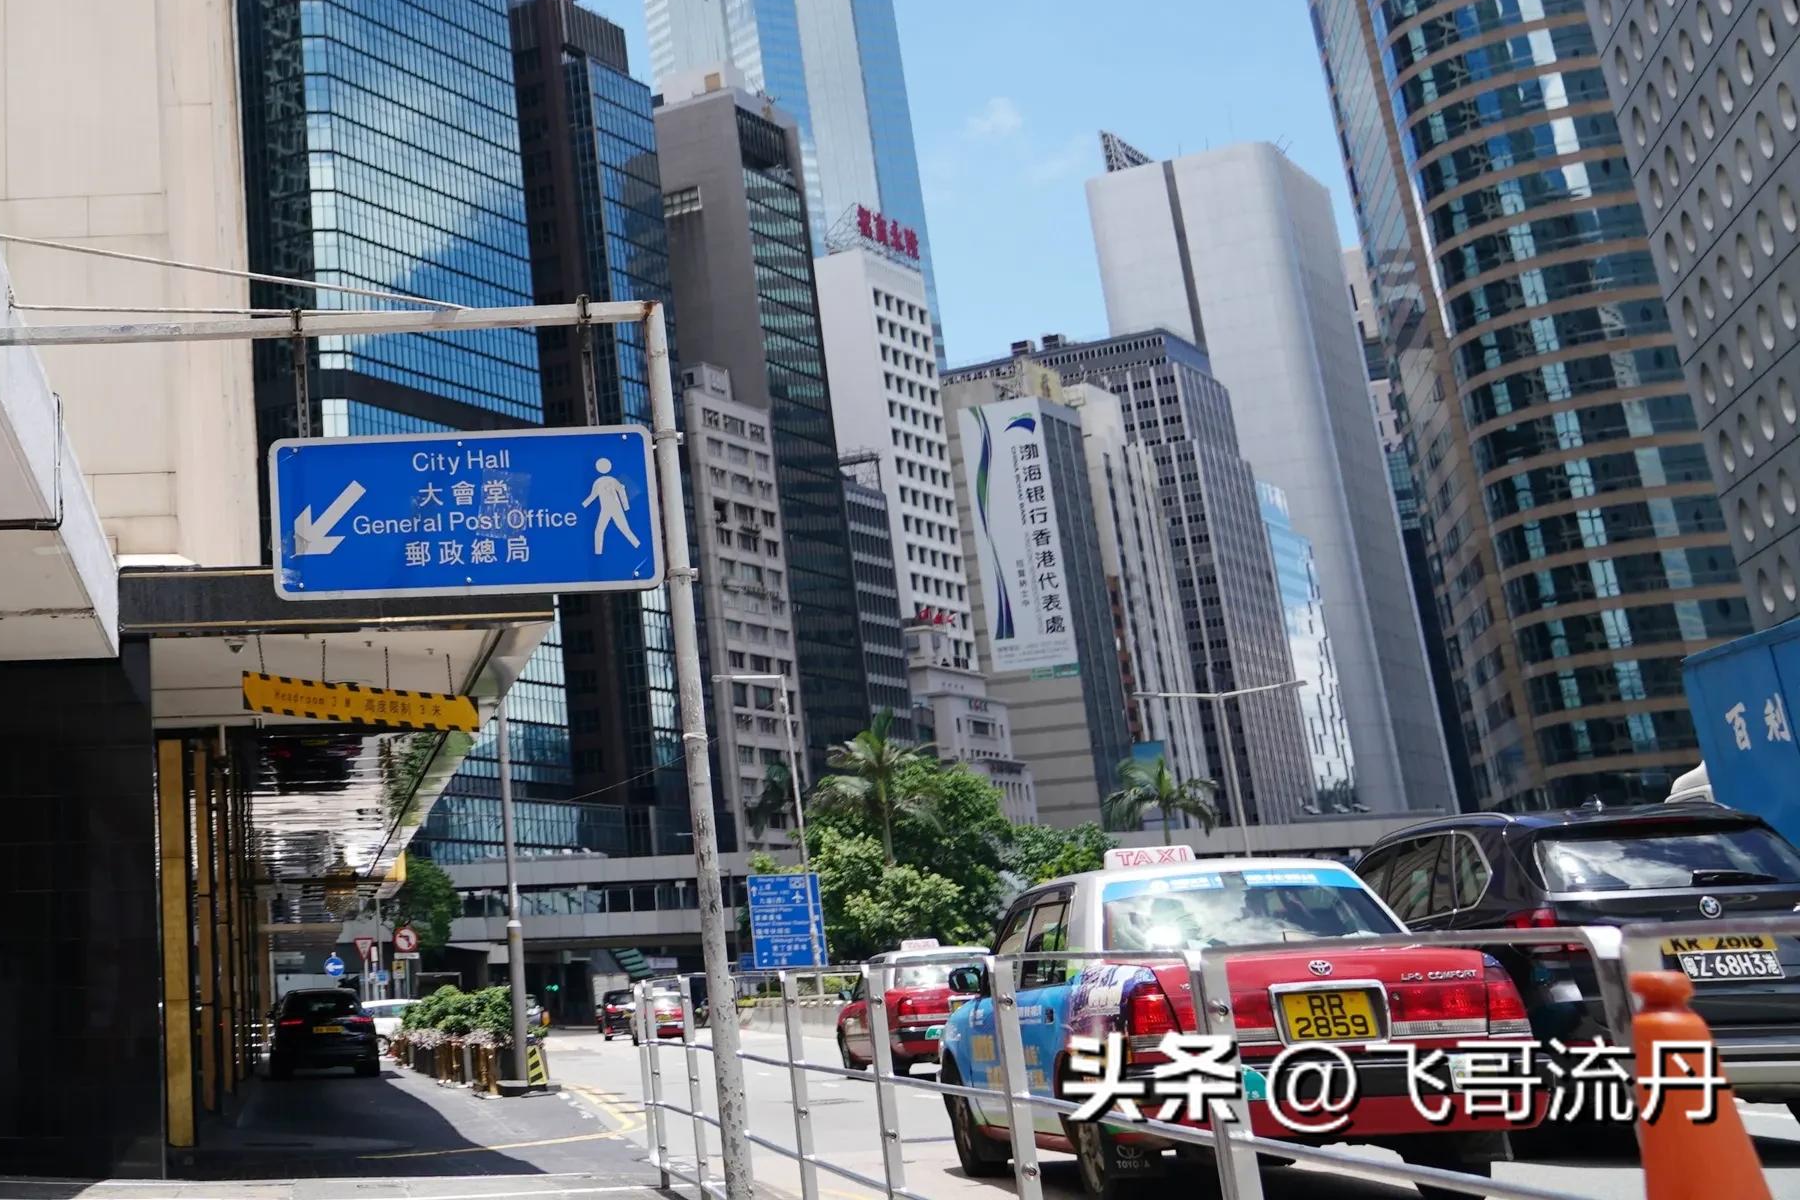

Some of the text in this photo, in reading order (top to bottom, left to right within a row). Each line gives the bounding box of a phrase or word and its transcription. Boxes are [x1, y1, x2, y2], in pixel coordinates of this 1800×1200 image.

[412, 449, 510, 475] City Hall
[418, 479, 509, 507] 大會堂
[353, 508, 577, 535] General Post Office
[405, 536, 530, 567] 郵政總局
[1725, 692, 1791, 750] 百利
[1115, 848, 1187, 866] TAXI
[1427, 969, 1477, 980] COMFORT
[1308, 994, 1344, 1016] RR
[1295, 1014, 1368, 1038] 2859
